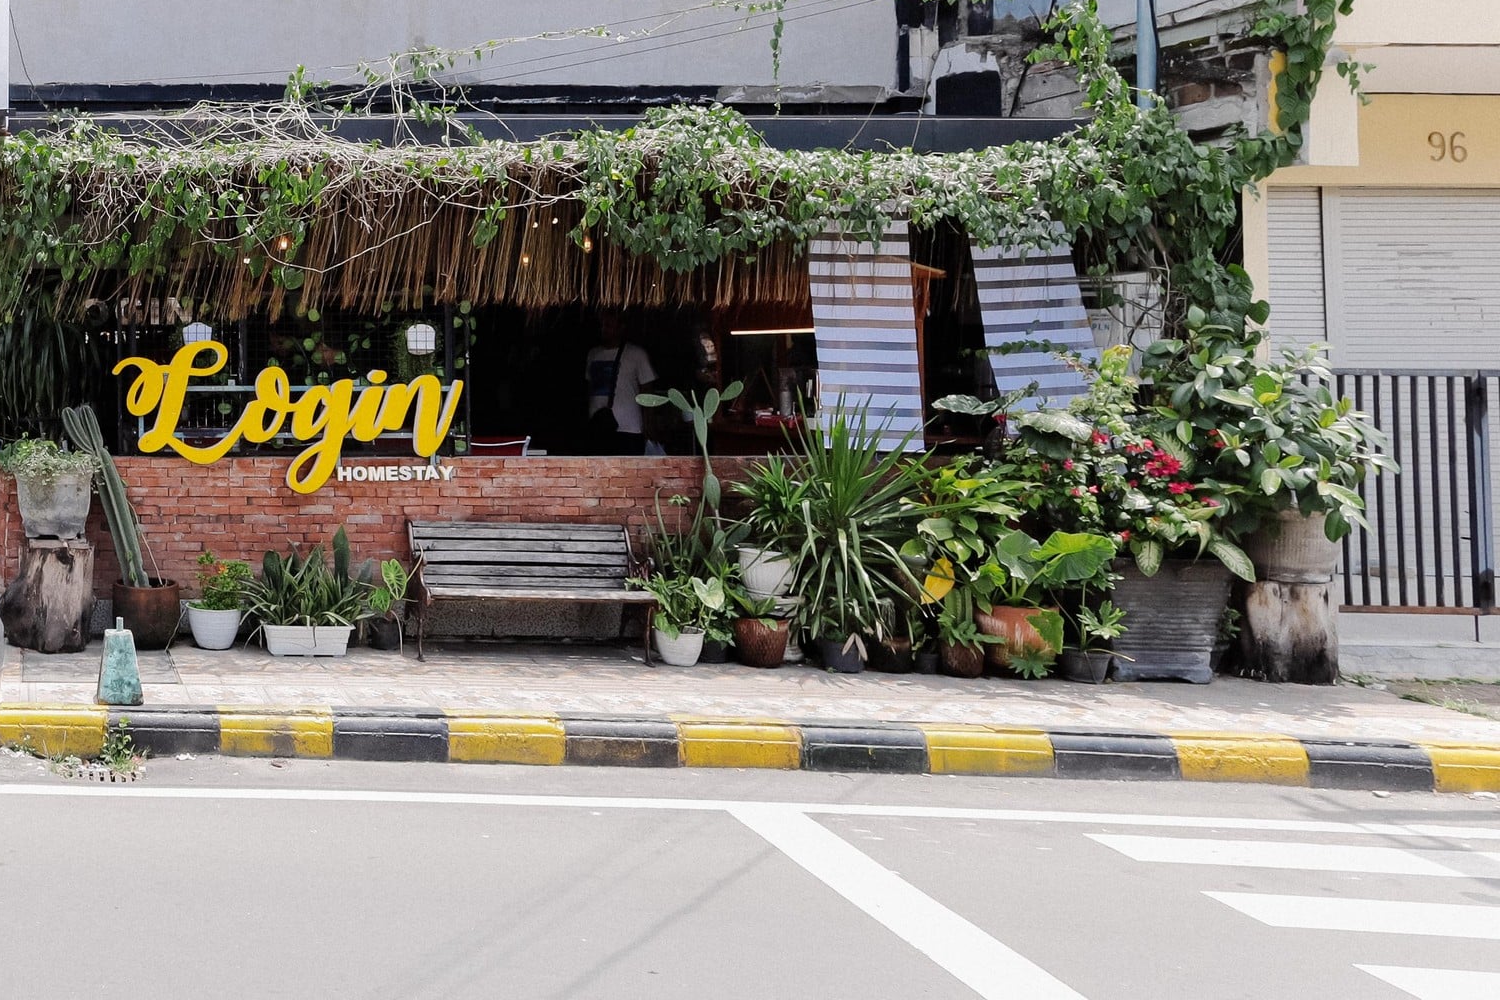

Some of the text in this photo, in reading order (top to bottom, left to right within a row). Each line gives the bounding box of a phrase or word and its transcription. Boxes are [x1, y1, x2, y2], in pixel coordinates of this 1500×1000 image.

[1427, 131, 1468, 163] 96
[112, 340, 464, 494] Login
[336, 464, 455, 482] HOMESTAY
